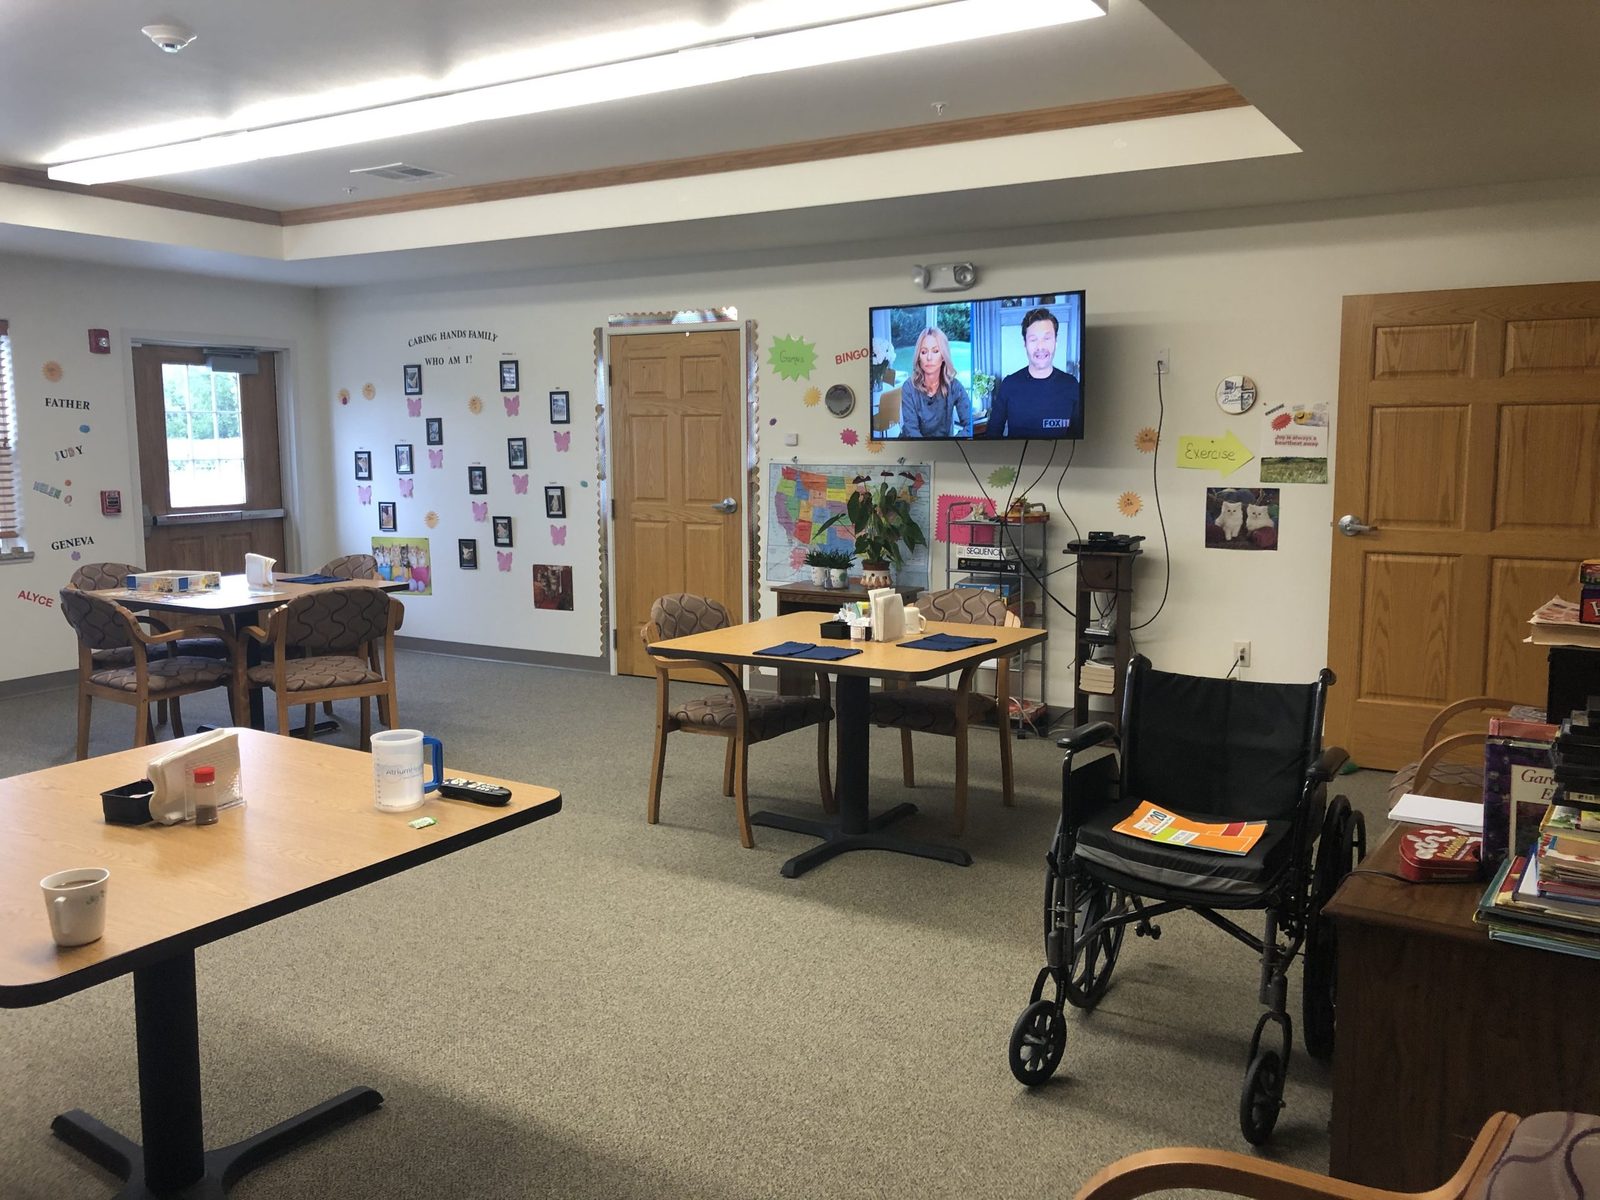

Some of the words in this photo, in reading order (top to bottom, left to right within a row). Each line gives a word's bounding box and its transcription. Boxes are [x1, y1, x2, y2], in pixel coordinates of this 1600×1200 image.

[408, 333, 437, 347] CARING
[440, 330, 467, 340] HANDS
[468, 330, 498, 342] FAMILY
[425, 357, 444, 366] WHO
[448, 355, 461, 364] AM
[465, 354, 473, 364] I?
[835, 347, 869, 365] BINGO
[45, 397, 90, 410] FATHER
[55, 445, 83, 461] JUDY
[1184, 442, 1237, 461] Exercise
[51, 536, 94, 550] GENEVA
[966, 547, 1003, 556] SEQUENC
[18, 590, 54, 608] ALYCE
